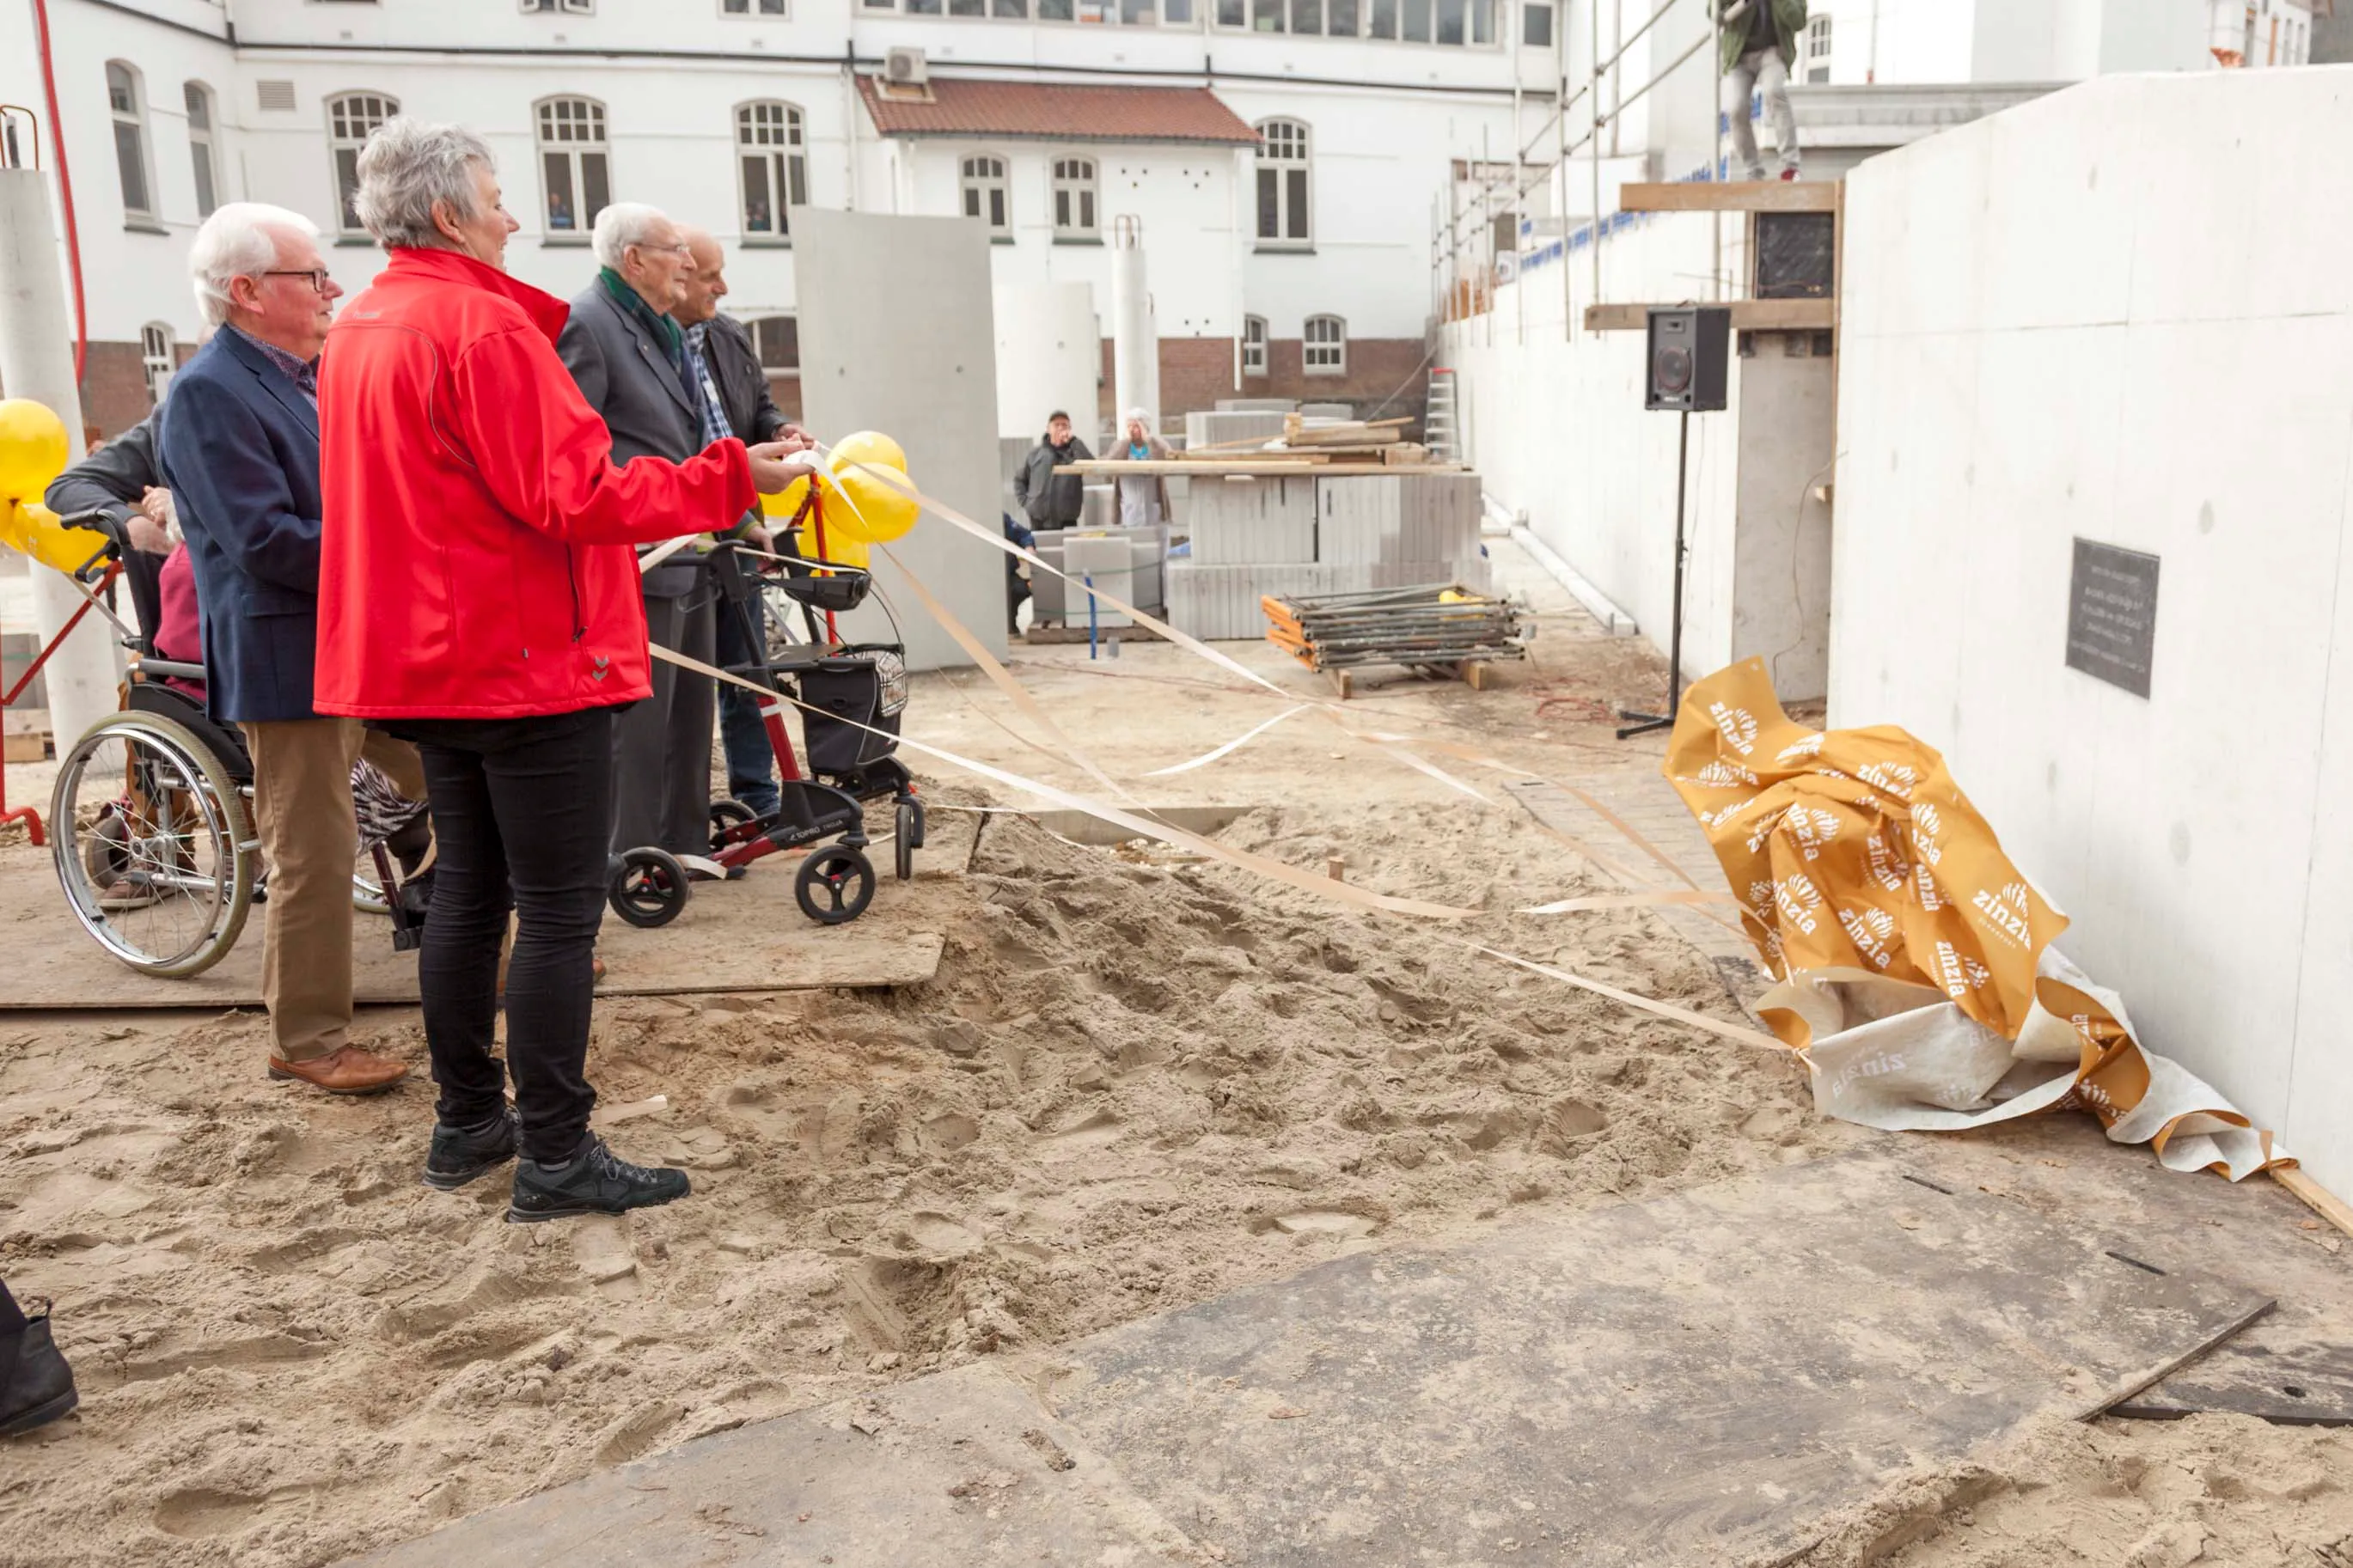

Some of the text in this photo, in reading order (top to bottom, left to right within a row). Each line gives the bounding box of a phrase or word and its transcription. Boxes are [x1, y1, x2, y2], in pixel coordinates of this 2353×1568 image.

[1709, 701, 1754, 756] zinzia
[796, 826, 821, 840] TOPRO
[1787, 802, 1820, 862] inzia
[1867, 835, 1902, 891] zinzia
[1838, 907, 1891, 969] zinzia
[1935, 941, 1970, 997] zinzia
